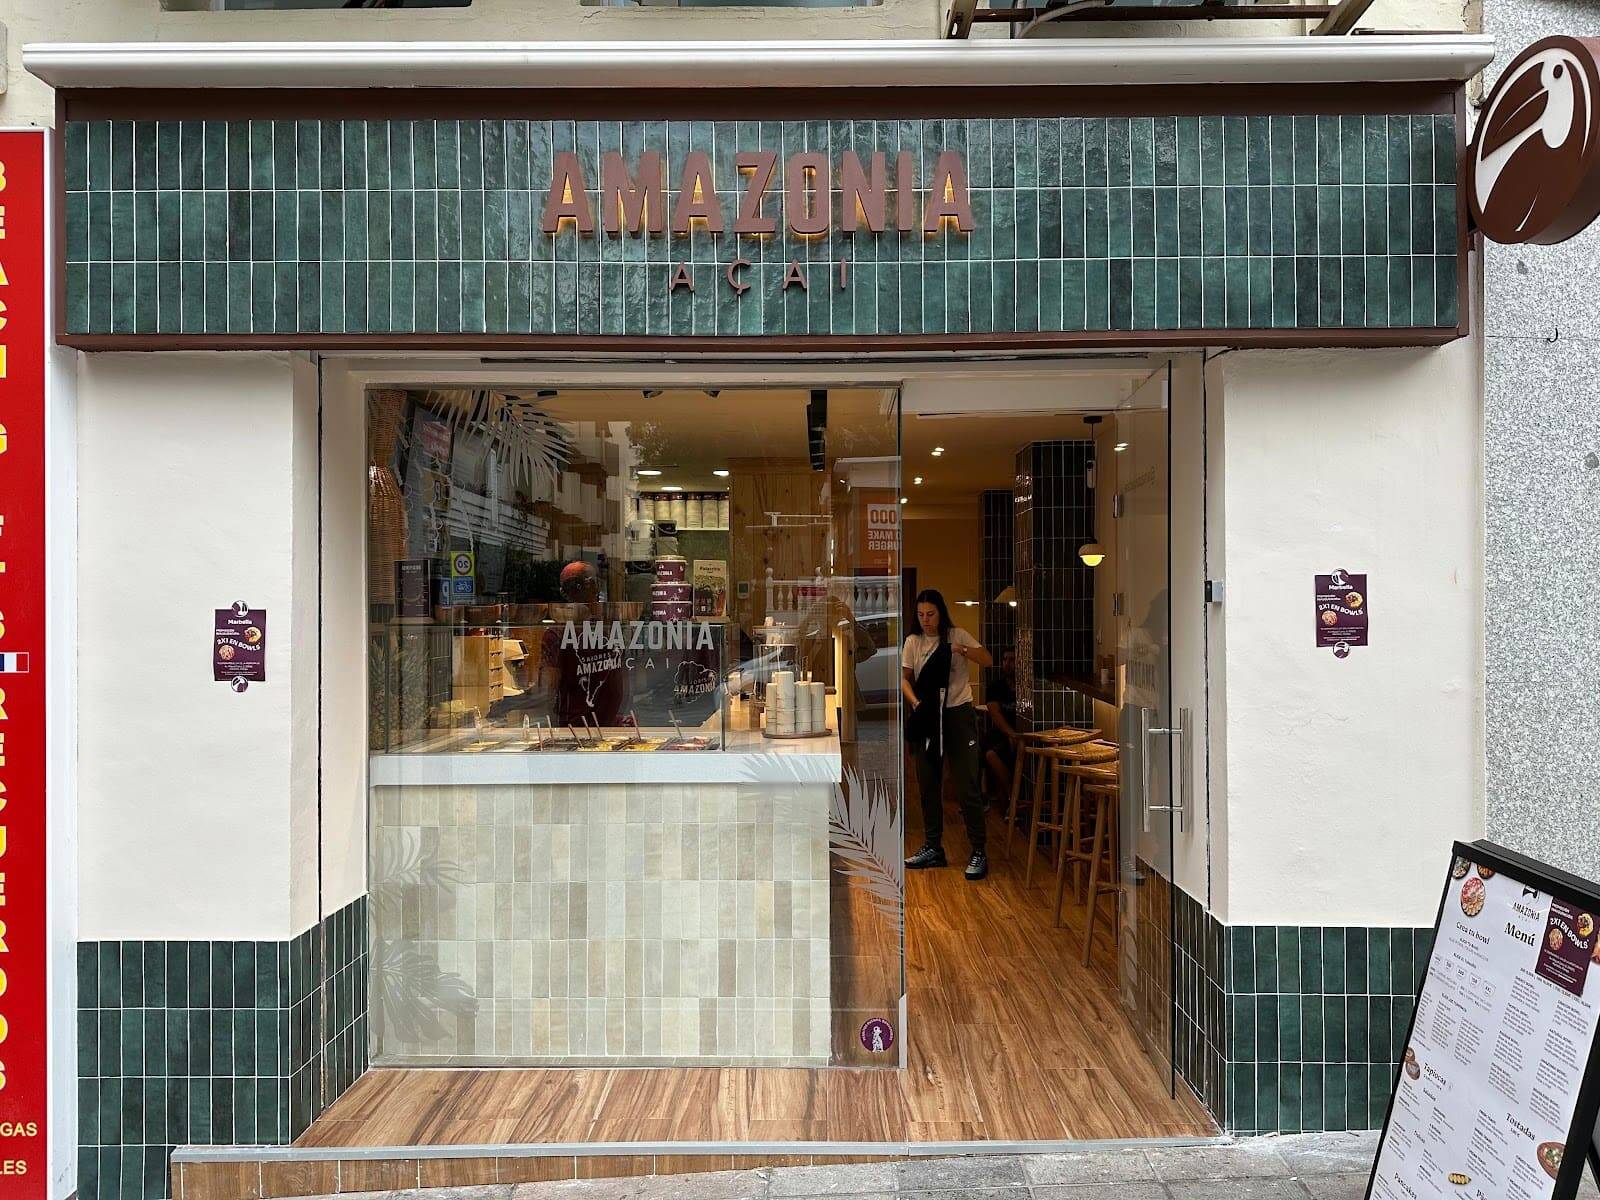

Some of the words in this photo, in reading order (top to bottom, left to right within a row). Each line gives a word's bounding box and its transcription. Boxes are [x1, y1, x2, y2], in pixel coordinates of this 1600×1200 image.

[542, 151, 974, 236] AMAZONIA
[670, 260, 848, 295] AÇAI
[560, 620, 714, 650] AMAZONIA
[1512, 902, 1540, 920] AMAZONIA
[1504, 922, 1535, 947] Menú
[1560, 921, 1569, 933] EN
[1423, 1062, 1446, 1085] Tapiocas
[1506, 1112, 1535, 1140] Tostadas
[1394, 1172, 1417, 1200] Pancakes
